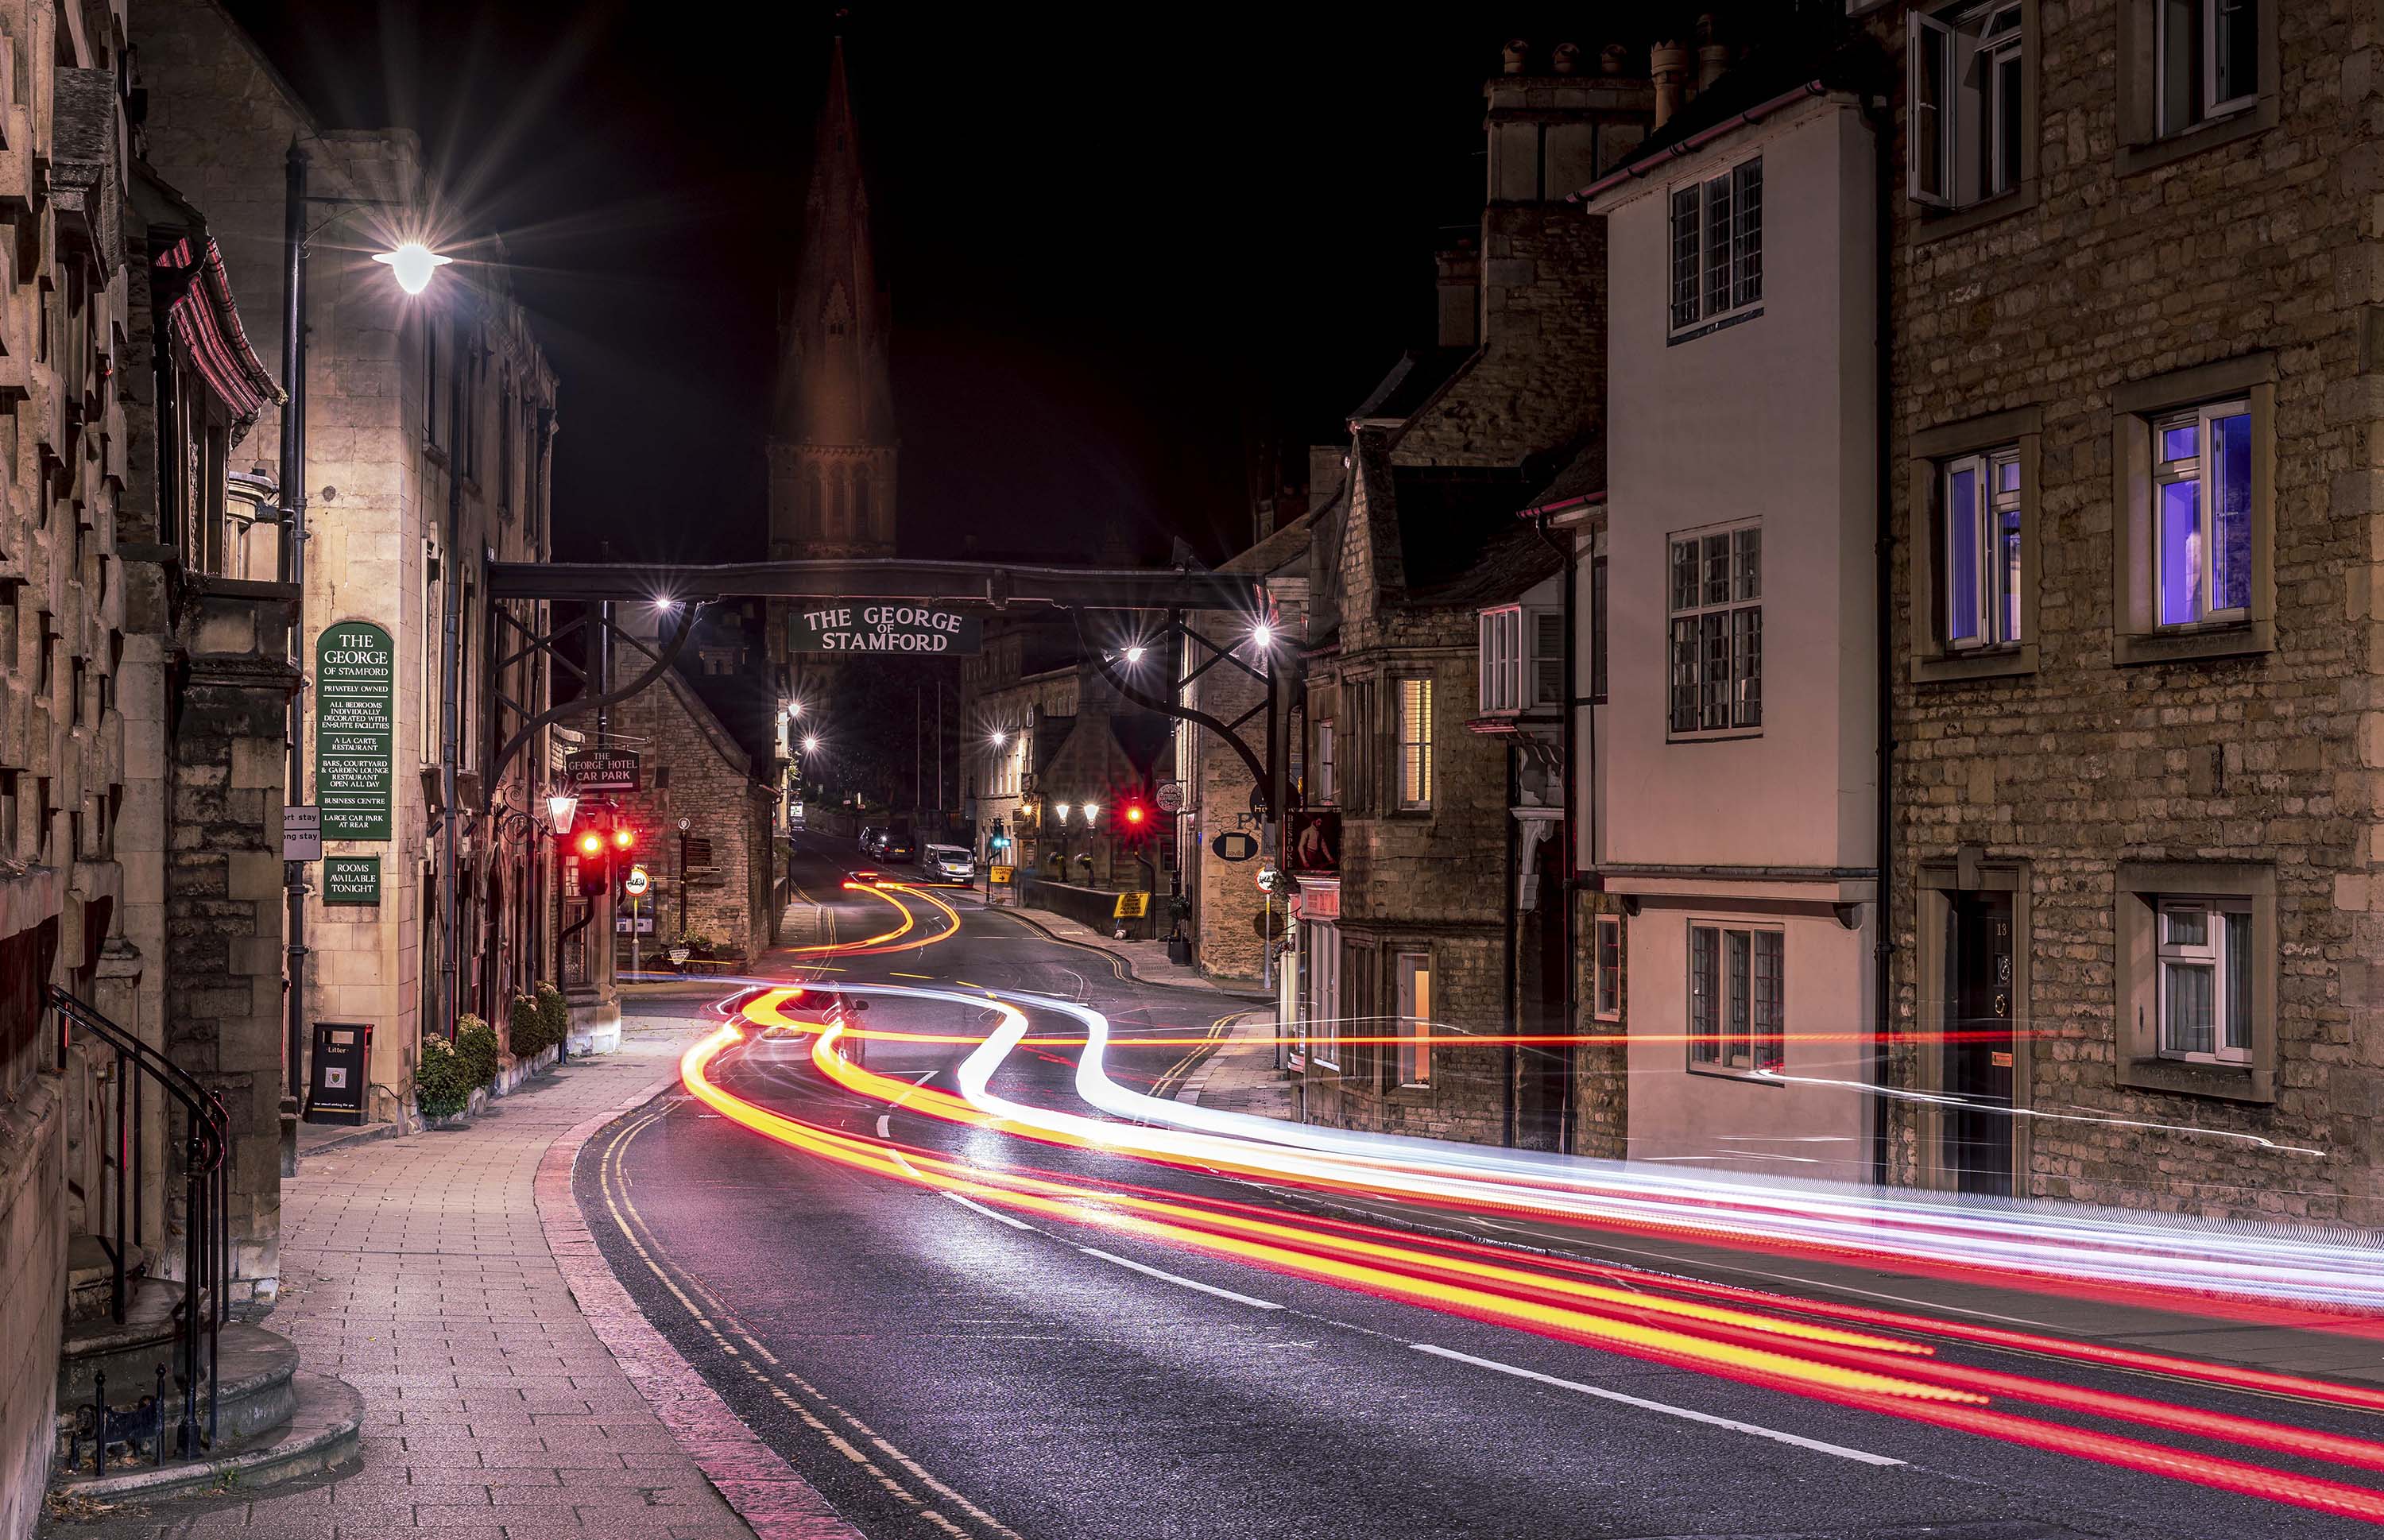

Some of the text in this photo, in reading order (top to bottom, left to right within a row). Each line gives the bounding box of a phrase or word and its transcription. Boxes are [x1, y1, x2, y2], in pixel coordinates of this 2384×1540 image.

[803, 606, 962, 633] THE GEORGE
[877, 624, 895, 633] OF
[339, 635, 373, 648] THE
[822, 633, 947, 652] STAMFORD
[324, 650, 388, 664] GEORGE
[339, 667, 389, 676] STAMFORD
[594, 752, 610, 760] THE
[568, 760, 638, 771] GEORGE HOTEL
[575, 770, 630, 781] CAR PARK
[337, 864, 370, 873] ROOMS
[1997, 923, 2007, 936] 13
